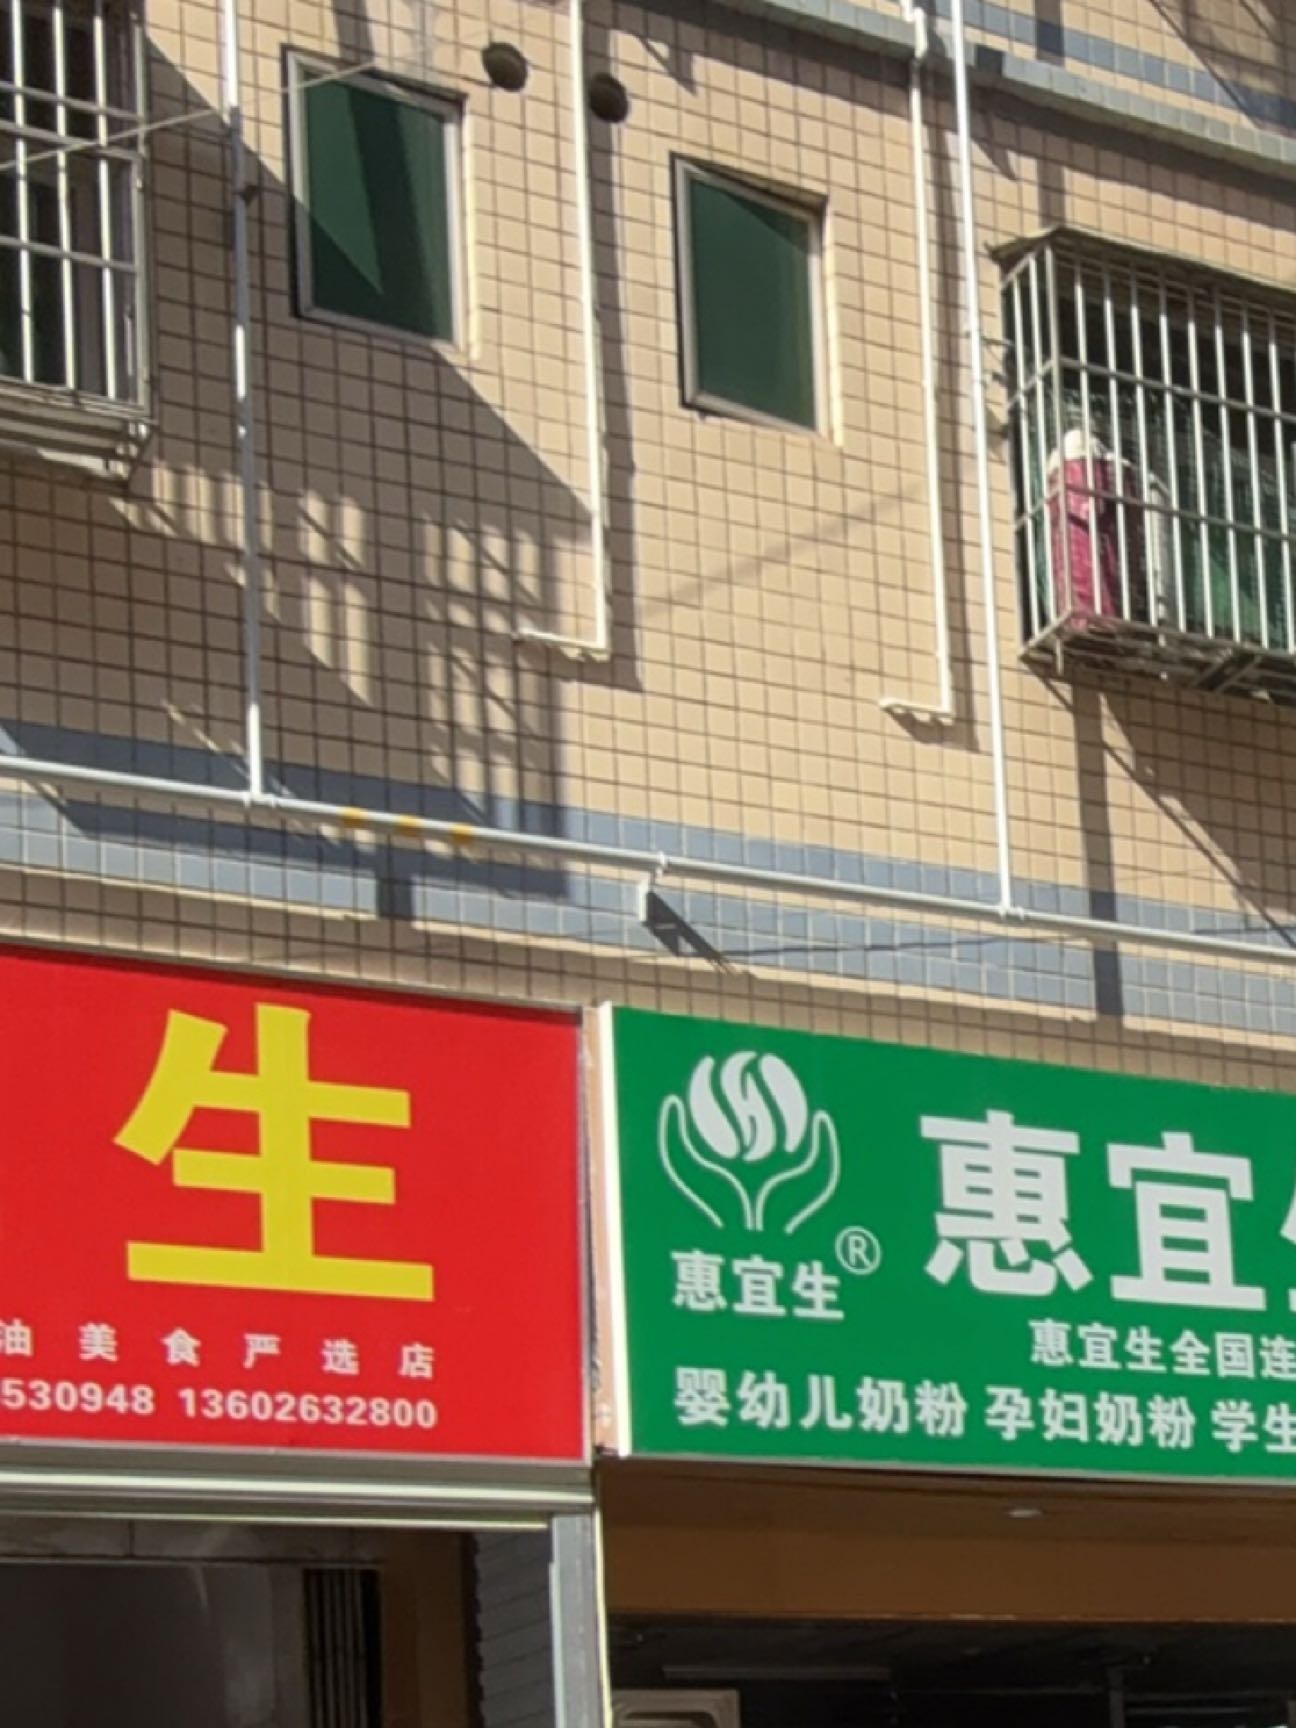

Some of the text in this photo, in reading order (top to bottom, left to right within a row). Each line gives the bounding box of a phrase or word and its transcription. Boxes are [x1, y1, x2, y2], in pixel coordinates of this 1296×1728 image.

[113, 1001, 435, 1302] 生
[670, 1249, 846, 1321] 惠宜生
[178, 1387, 439, 1429] 13602632800
[673, 1365, 968, 1437] 婴幼儿奶粉
[984, 1384, 1196, 1449] 孕妇奶粉
